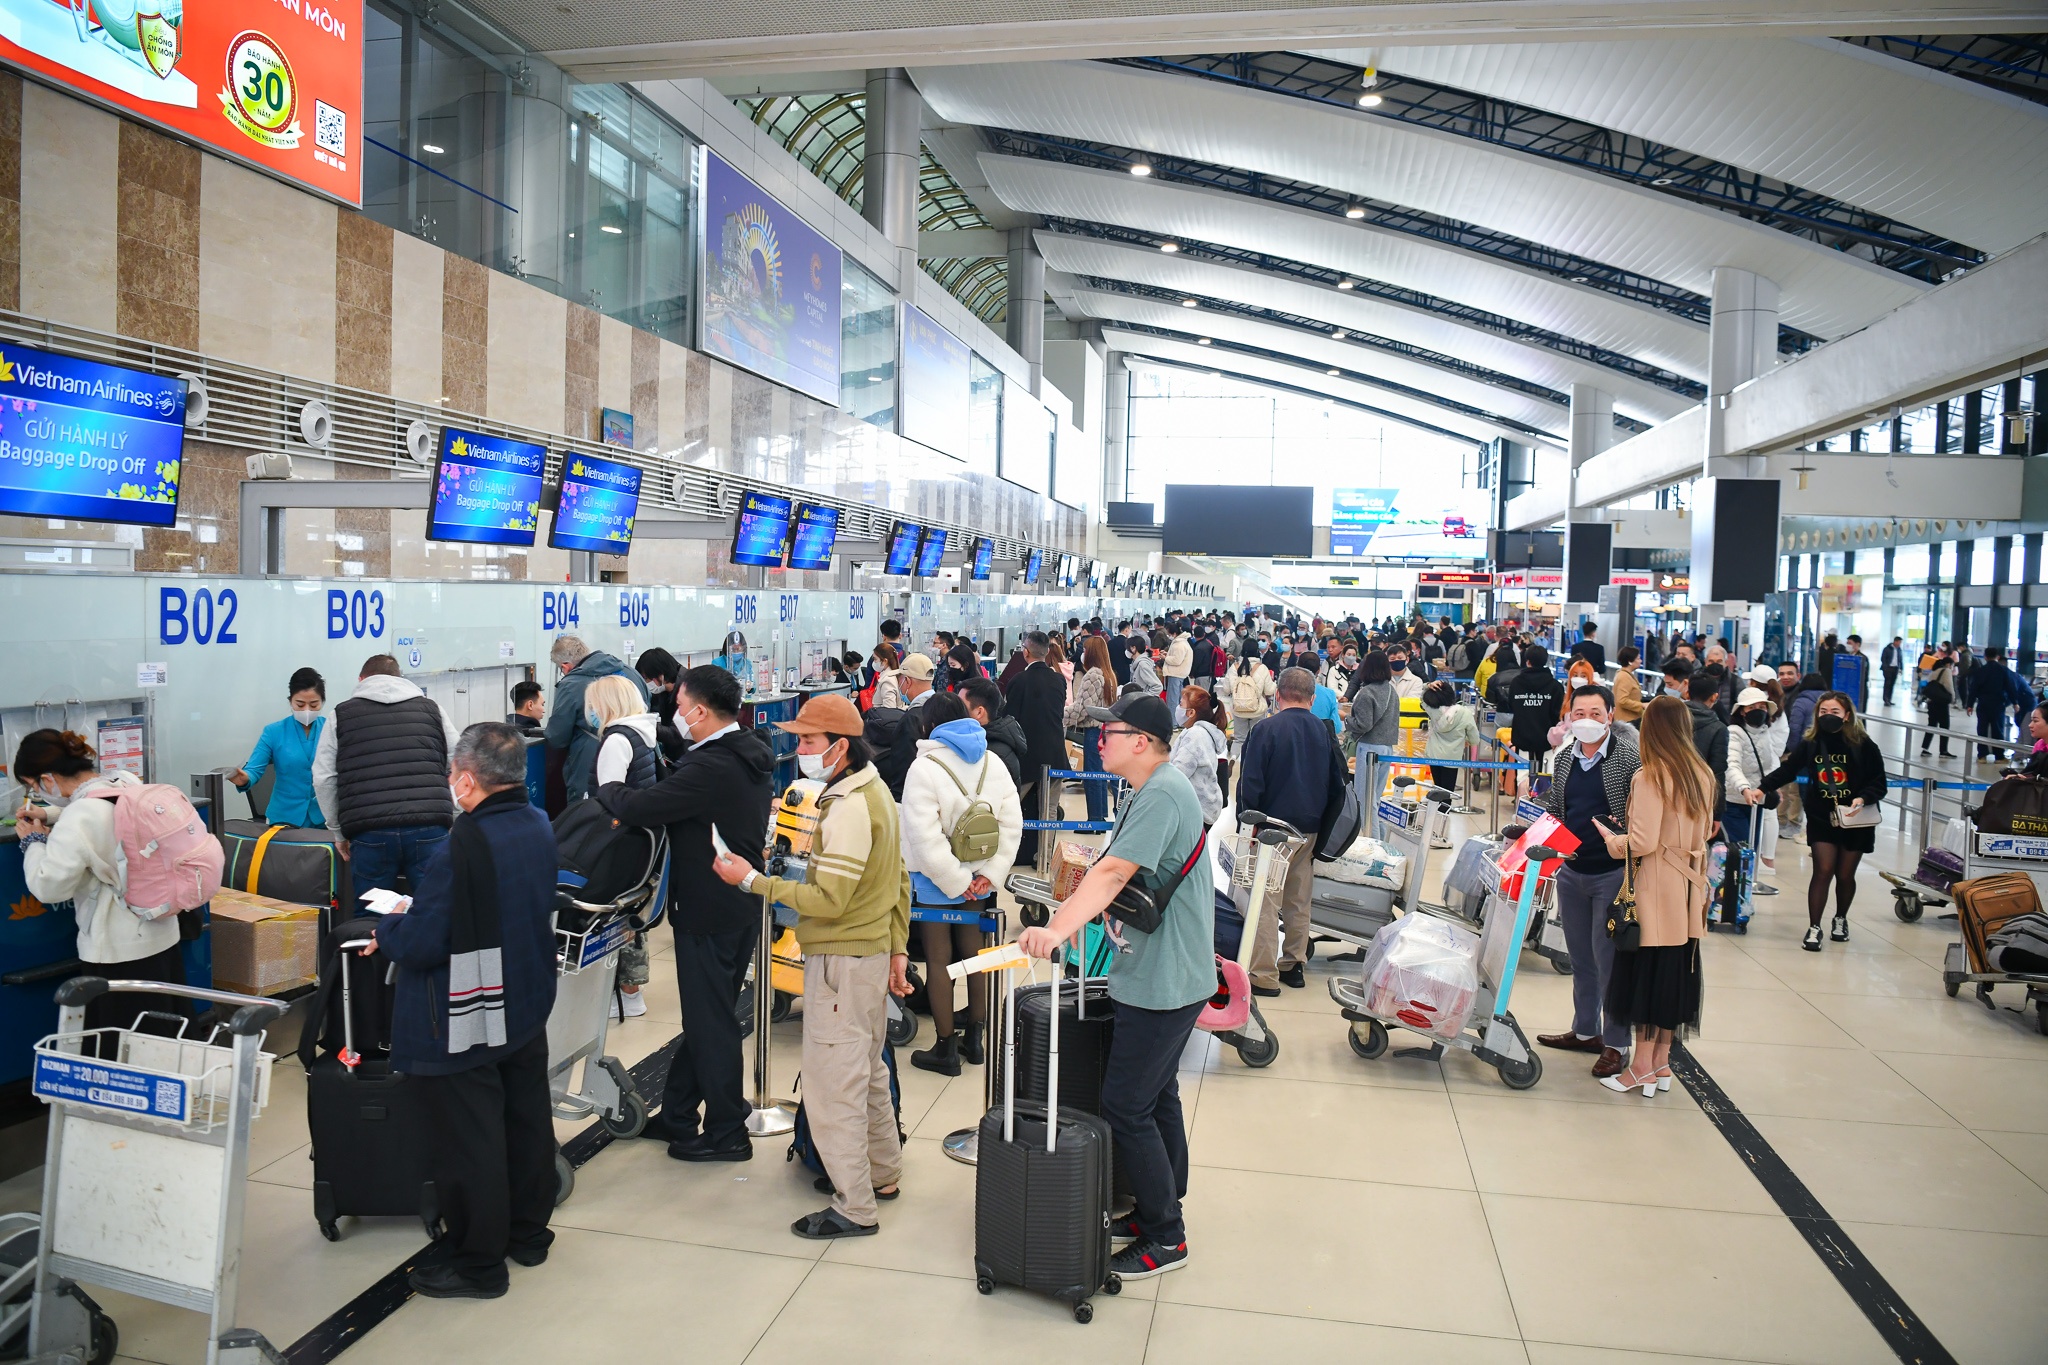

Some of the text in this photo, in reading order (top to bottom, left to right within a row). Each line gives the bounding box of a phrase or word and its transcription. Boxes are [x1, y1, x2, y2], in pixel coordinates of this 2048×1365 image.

[304, 2, 346, 41] MÒN
[147, 42, 174, 58] ĂN MÒN
[148, 34, 173, 47] CHỐNG
[247, 48, 281, 71] BẢO HÀNH
[242, 60, 284, 111] 30
[257, 108, 271, 120] NĂM
[16, 363, 153, 407] Vietnam Airlines
[24, 417, 129, 451] GỬI HÀNH LÝ
[0, 440, 147, 475] Baggage Drop Off
[468, 443, 530, 467] Vietnam Airlines
[584, 465, 630, 487] Vietnam Airlines
[485, 481, 507, 496] HÀNH
[508, 483, 517, 497] LÝ
[456, 494, 524, 513] Baggage Drop Off
[572, 508, 623, 526] Baggage Drop Off
[160, 586, 238, 645] B02
[328, 589, 385, 639] B03
[543, 591, 579, 630] B04
[620, 592, 650, 627] B05
[735, 594, 757, 623] B06
[780, 594, 799, 622] B07
[849, 596, 864, 619] B08
[921, 596, 932, 617] B09
[398, 637, 414, 646] ACV
[1814, 754, 1847, 764] GCCI
[2012, 819, 2026, 830] BA
[910, 911, 923, 919] RT
[942, 913, 963, 921] N.I.A
